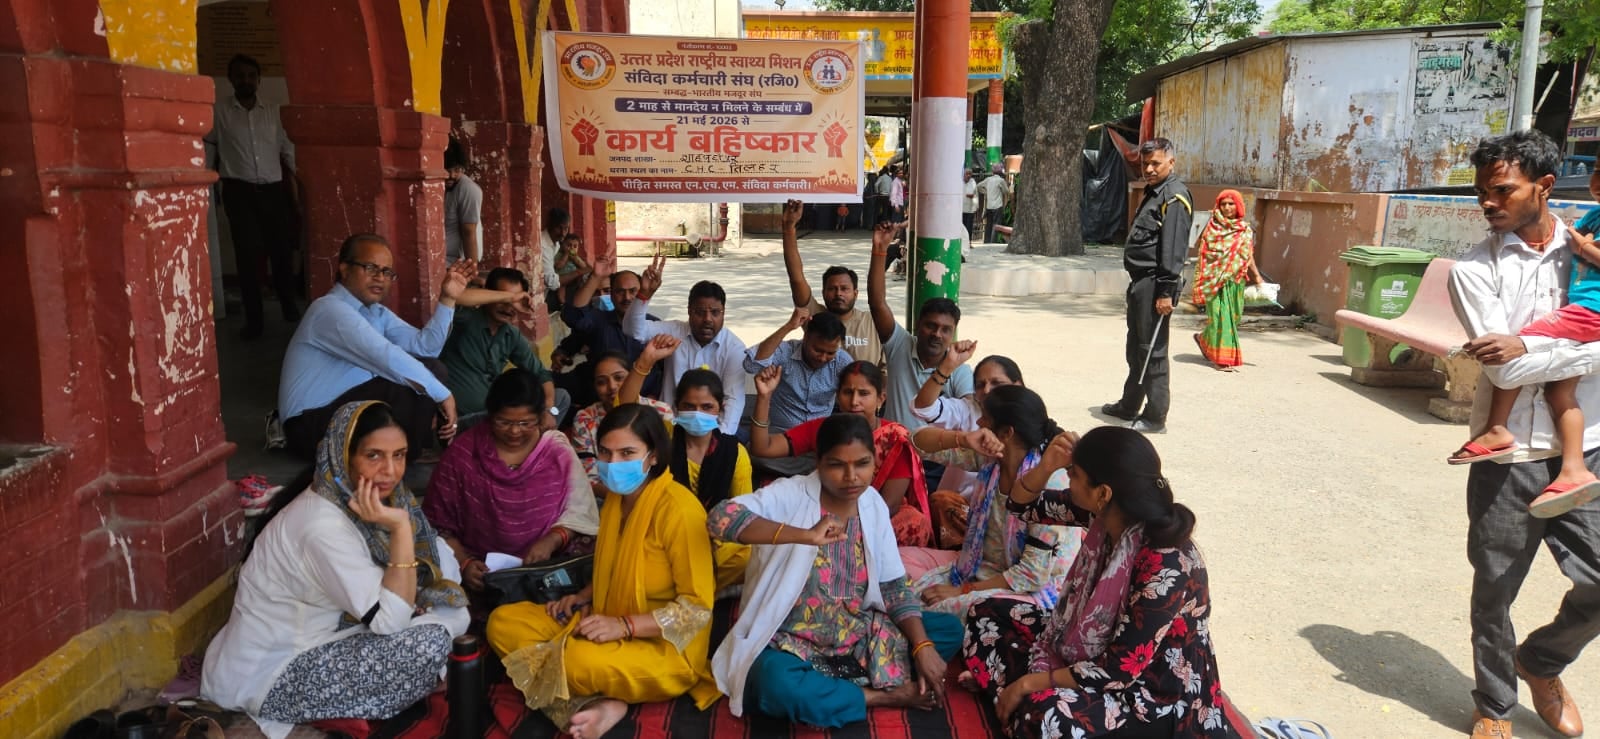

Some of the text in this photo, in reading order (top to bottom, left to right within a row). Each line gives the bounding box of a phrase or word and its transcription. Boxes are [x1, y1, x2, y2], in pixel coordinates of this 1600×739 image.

[620, 53, 652, 66] उत्तर
[656, 50, 685, 67] प्रदेश
[688, 52, 726, 70] राष्ट्रीय
[769, 53, 802, 69] मिशन
[624, 68, 668, 85] संविदा
[672, 70, 727, 86] कर्मचारी
[730, 72, 755, 86] संघ
[724, 90, 747, 99] मजदूर
[749, 89, 762, 98] संघ
[626, 100, 635, 110] 2
[639, 102, 658, 111] माह
[661, 101, 671, 111] से
[674, 101, 708, 111] मानदेय
[711, 103, 719, 111] न
[722, 101, 749, 112] मिलने
[752, 102, 762, 112] के
[795, 102, 803, 112] में
[677, 114, 750, 125] 21 मई 2026 से
[605, 124, 818, 157] कार्य बहिष्कार
[622, 179, 650, 191] पीड़ित
[654, 180, 681, 191] समस्त
[743, 179, 770, 190] संविदा
